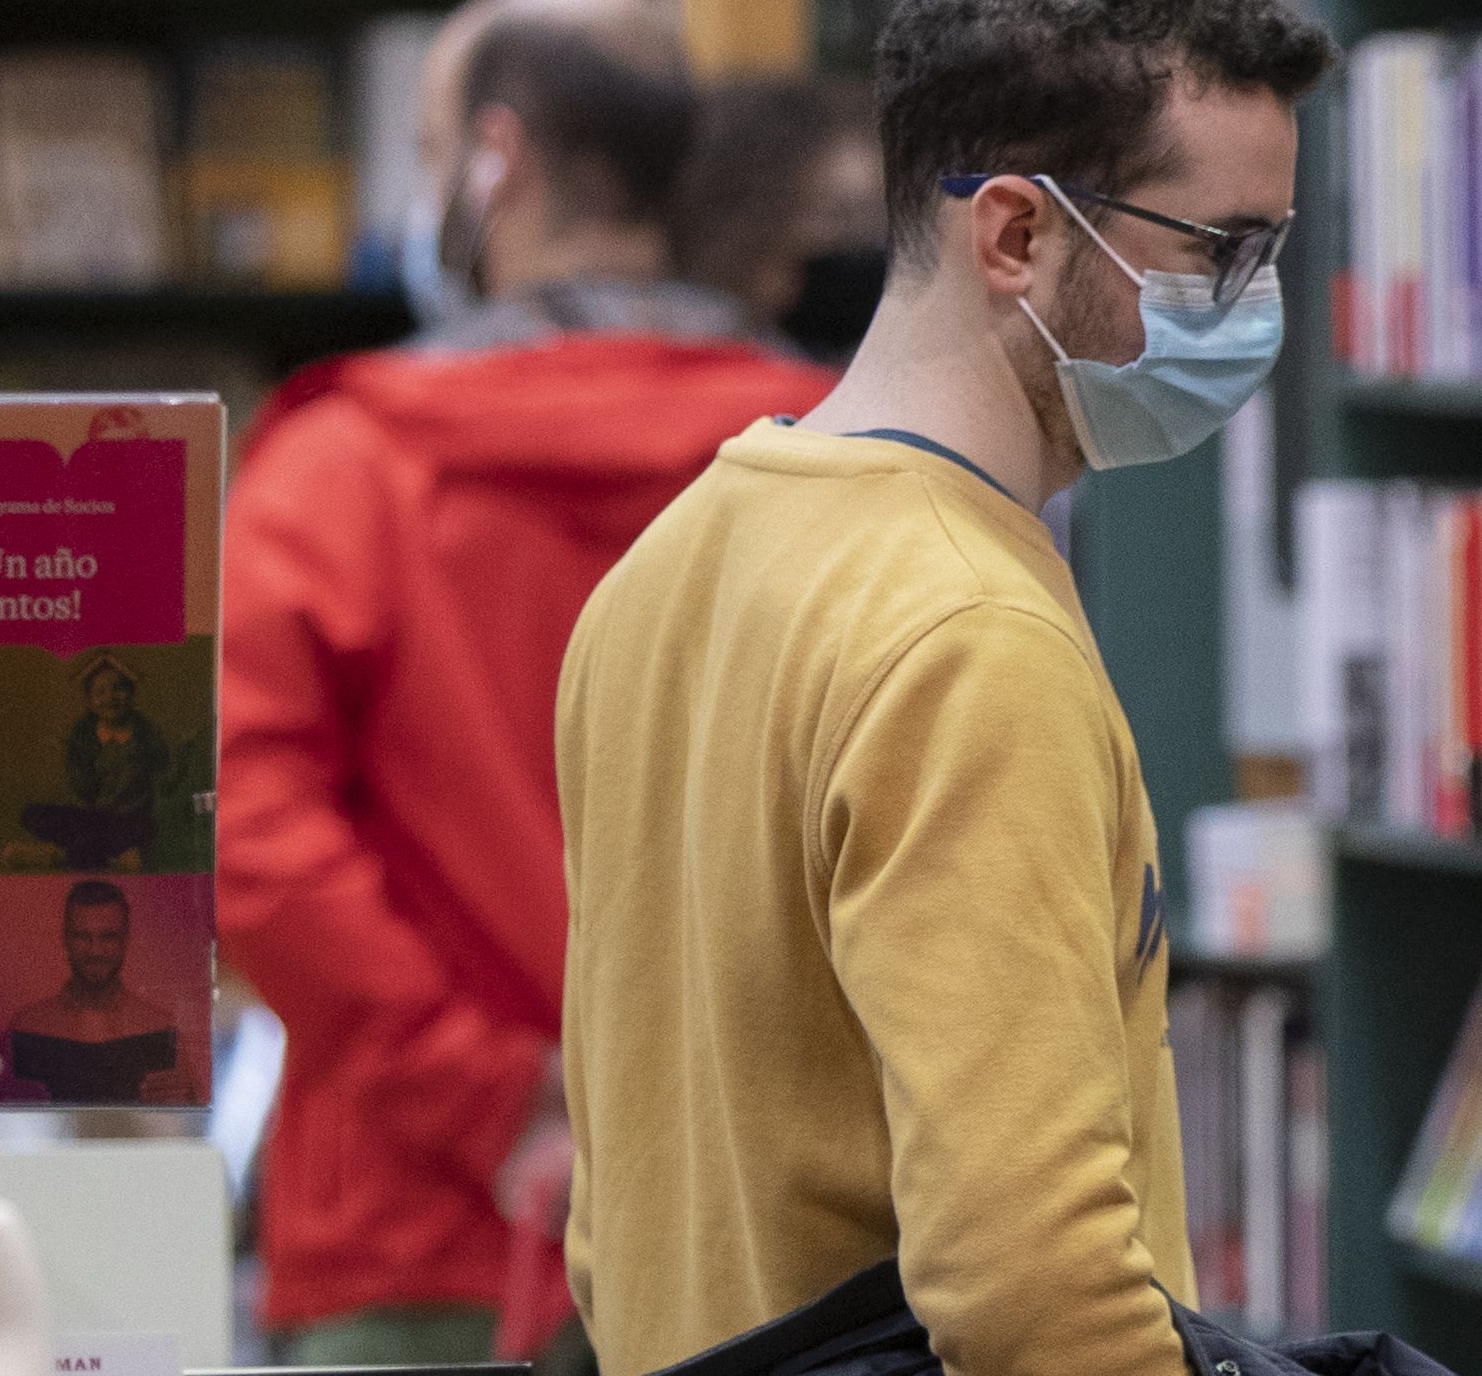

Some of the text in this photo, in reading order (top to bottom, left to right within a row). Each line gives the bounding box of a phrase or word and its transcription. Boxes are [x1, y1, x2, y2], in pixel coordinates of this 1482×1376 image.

[42, 499, 63, 514] de
[65, 499, 116, 514] Socios
[34, 546, 98, 580] año
